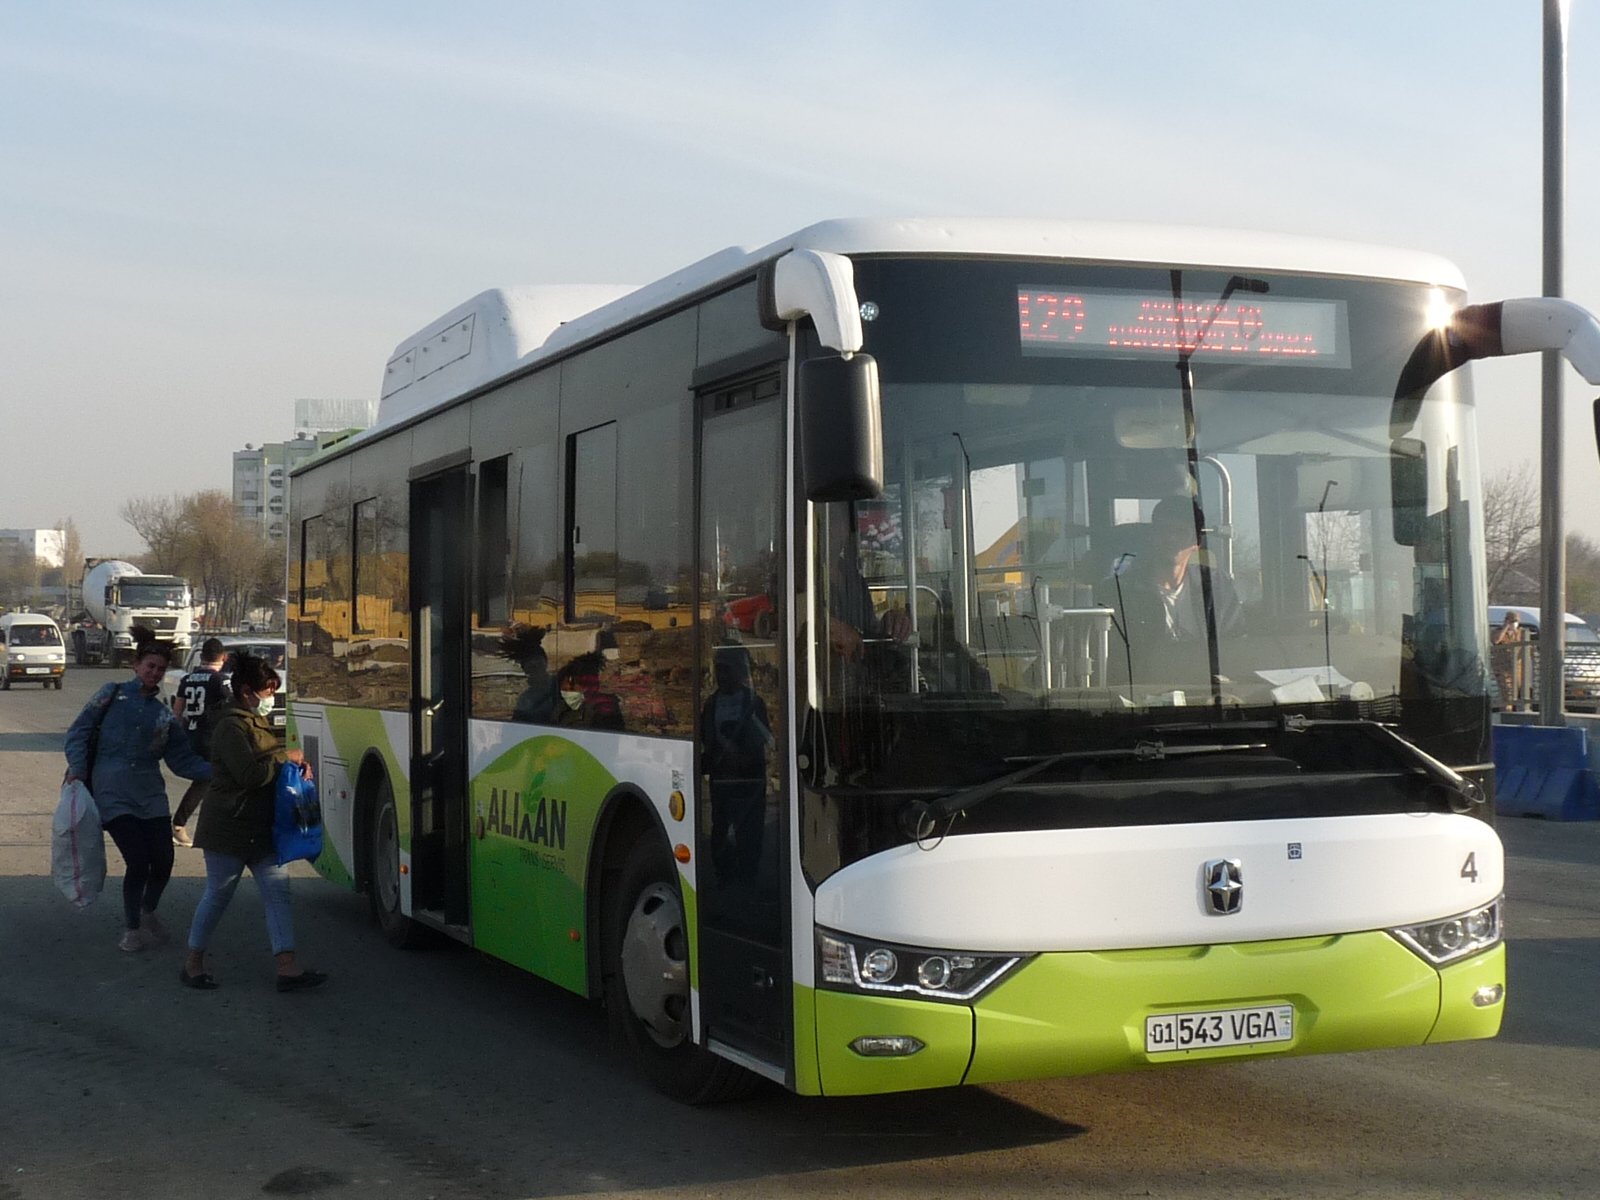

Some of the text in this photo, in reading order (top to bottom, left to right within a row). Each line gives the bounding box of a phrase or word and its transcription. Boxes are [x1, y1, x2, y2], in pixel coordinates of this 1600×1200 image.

[184, 686, 206, 716] 23
[1460, 851, 1478, 883] 4
[1153, 1023, 1174, 1044] 01
[1179, 1015, 1223, 1045] 543
[1230, 1011, 1277, 1040] VGA
